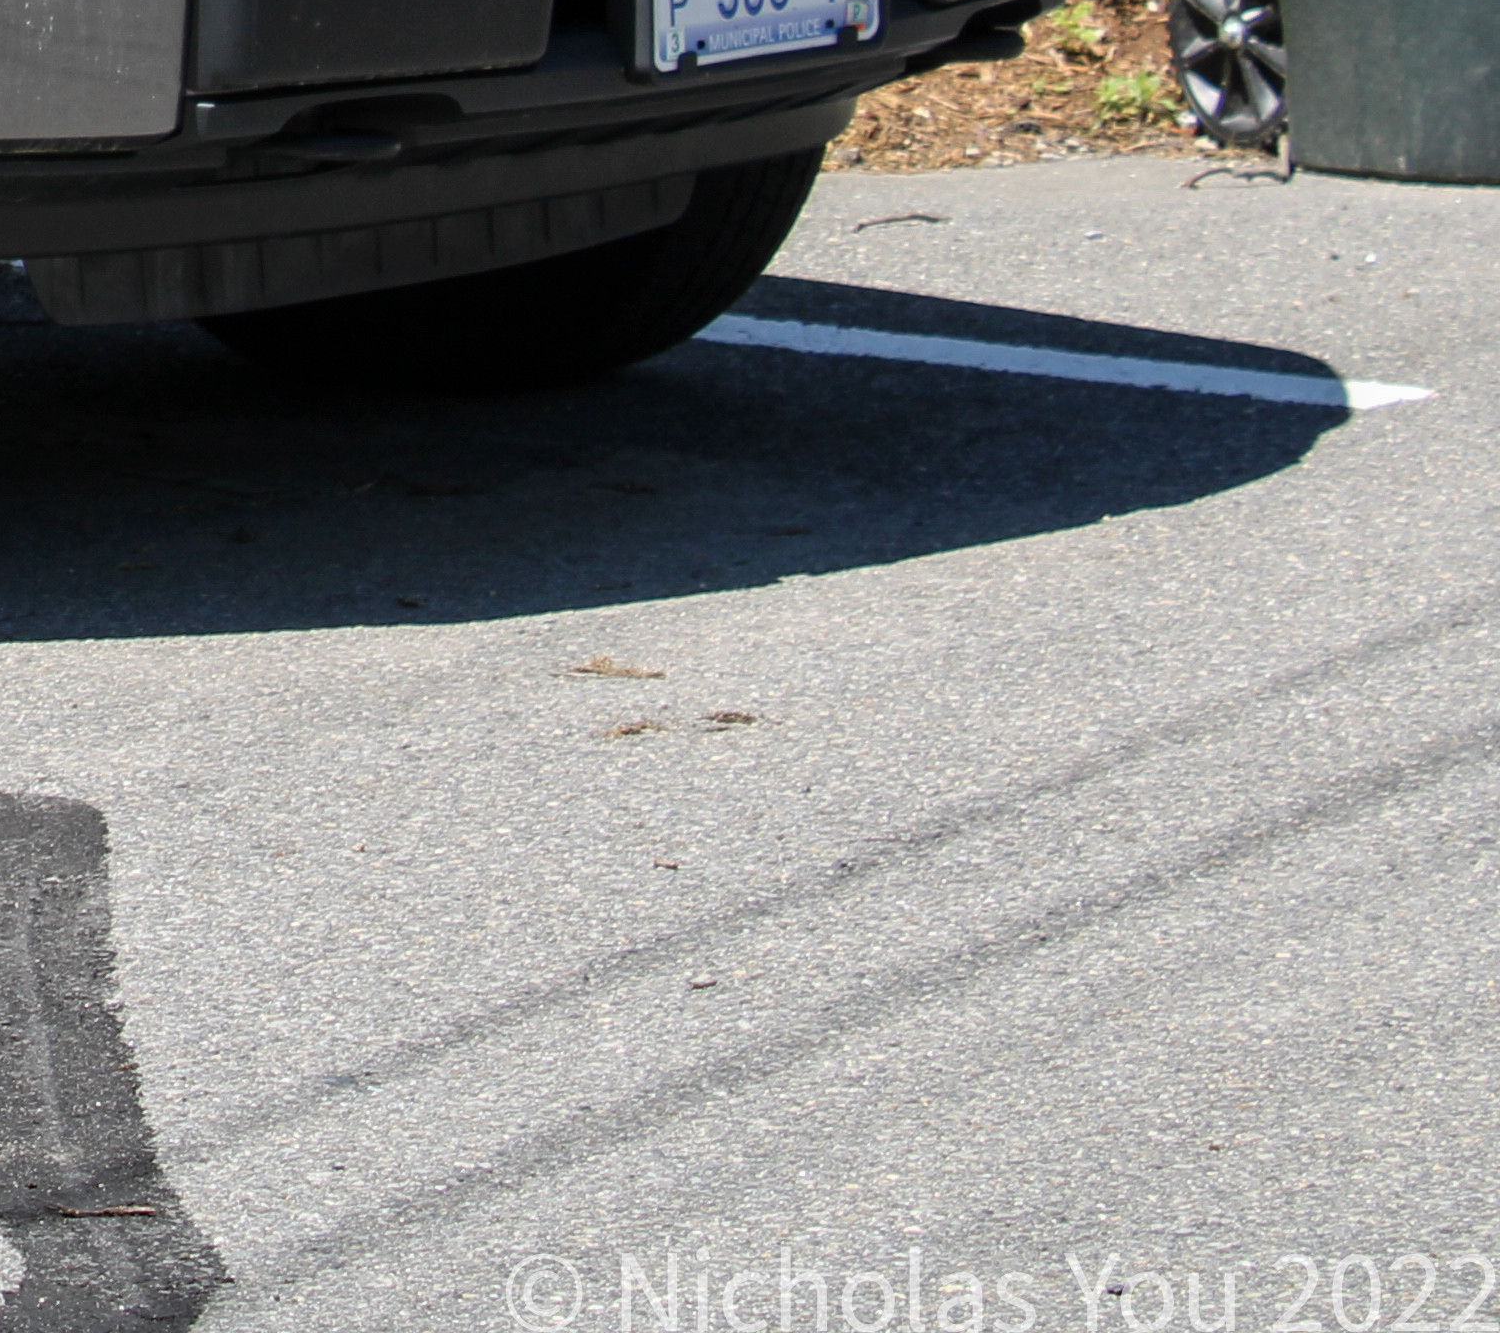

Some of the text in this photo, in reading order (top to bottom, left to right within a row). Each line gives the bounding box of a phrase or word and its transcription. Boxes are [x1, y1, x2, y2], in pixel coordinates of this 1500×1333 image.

[671, 34, 680, 53] 3
[708, 17, 823, 53] MUNICIPAL POLICE
